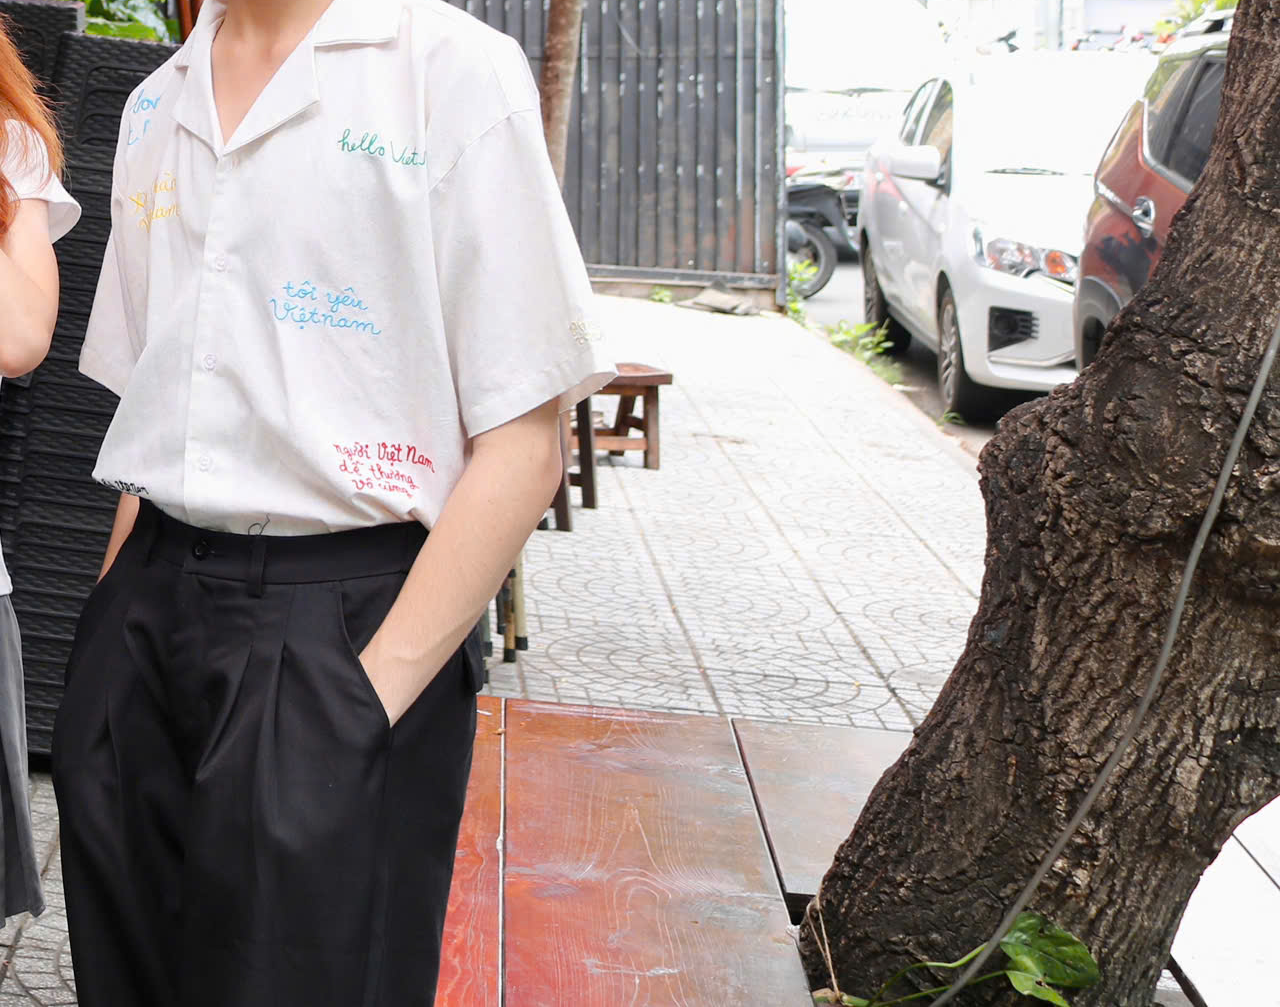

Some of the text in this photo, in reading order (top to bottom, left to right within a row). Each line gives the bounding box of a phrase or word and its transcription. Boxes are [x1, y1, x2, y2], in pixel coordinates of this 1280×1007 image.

[337, 128, 385, 157] hello
[282, 280, 369, 313] tôi yêu
[377, 442, 403, 467] Việt
[406, 444, 435, 473] Nam
